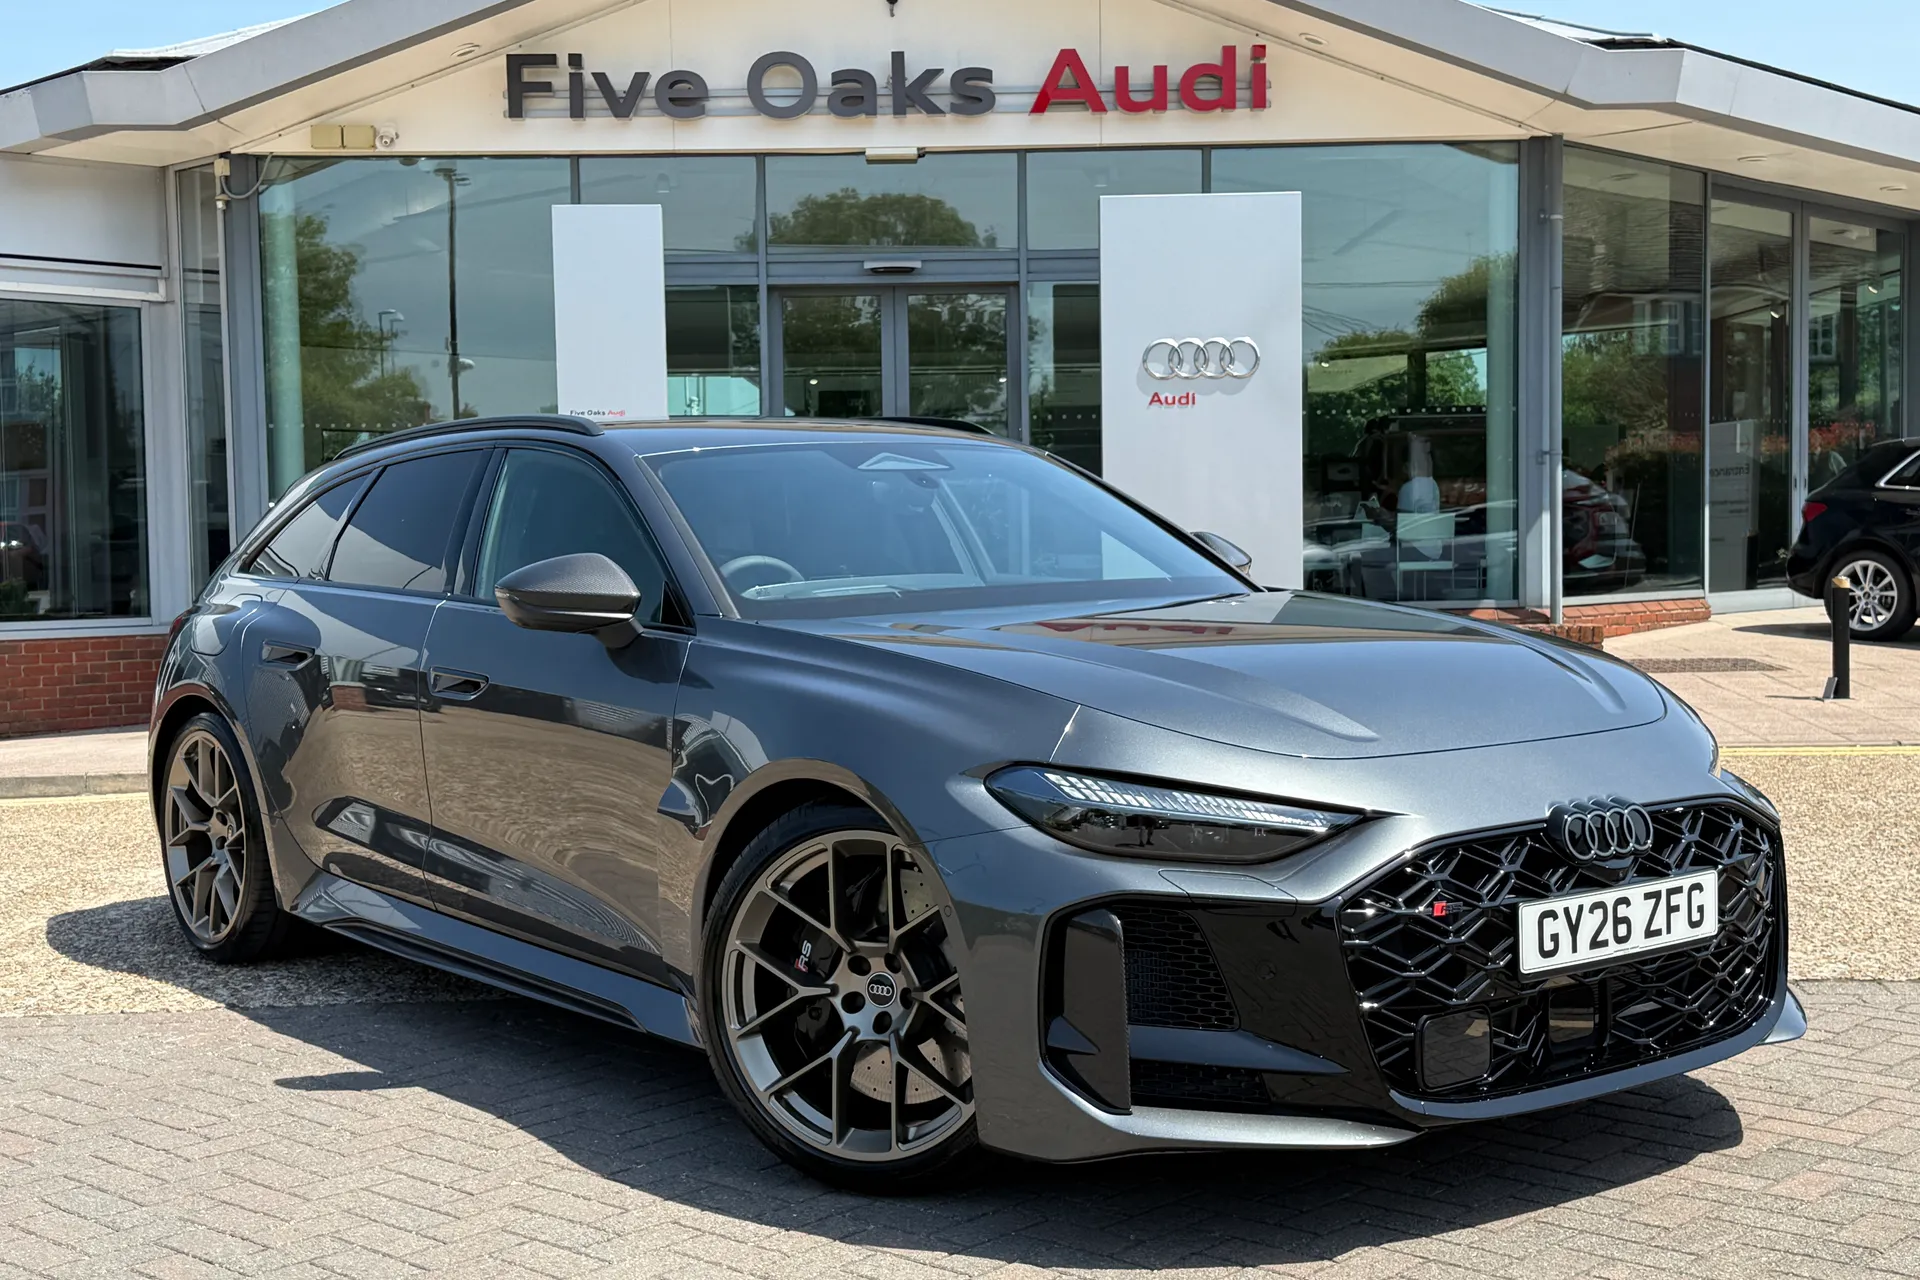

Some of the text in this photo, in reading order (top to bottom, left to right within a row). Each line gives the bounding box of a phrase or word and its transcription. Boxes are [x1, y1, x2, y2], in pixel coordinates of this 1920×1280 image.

[505, 44, 1268, 120] Five Oaks Audi
[1148, 392, 1196, 406] Audi
[1536, 882, 1704, 959] GY26 ZFG
[796, 940, 811, 972] RS
